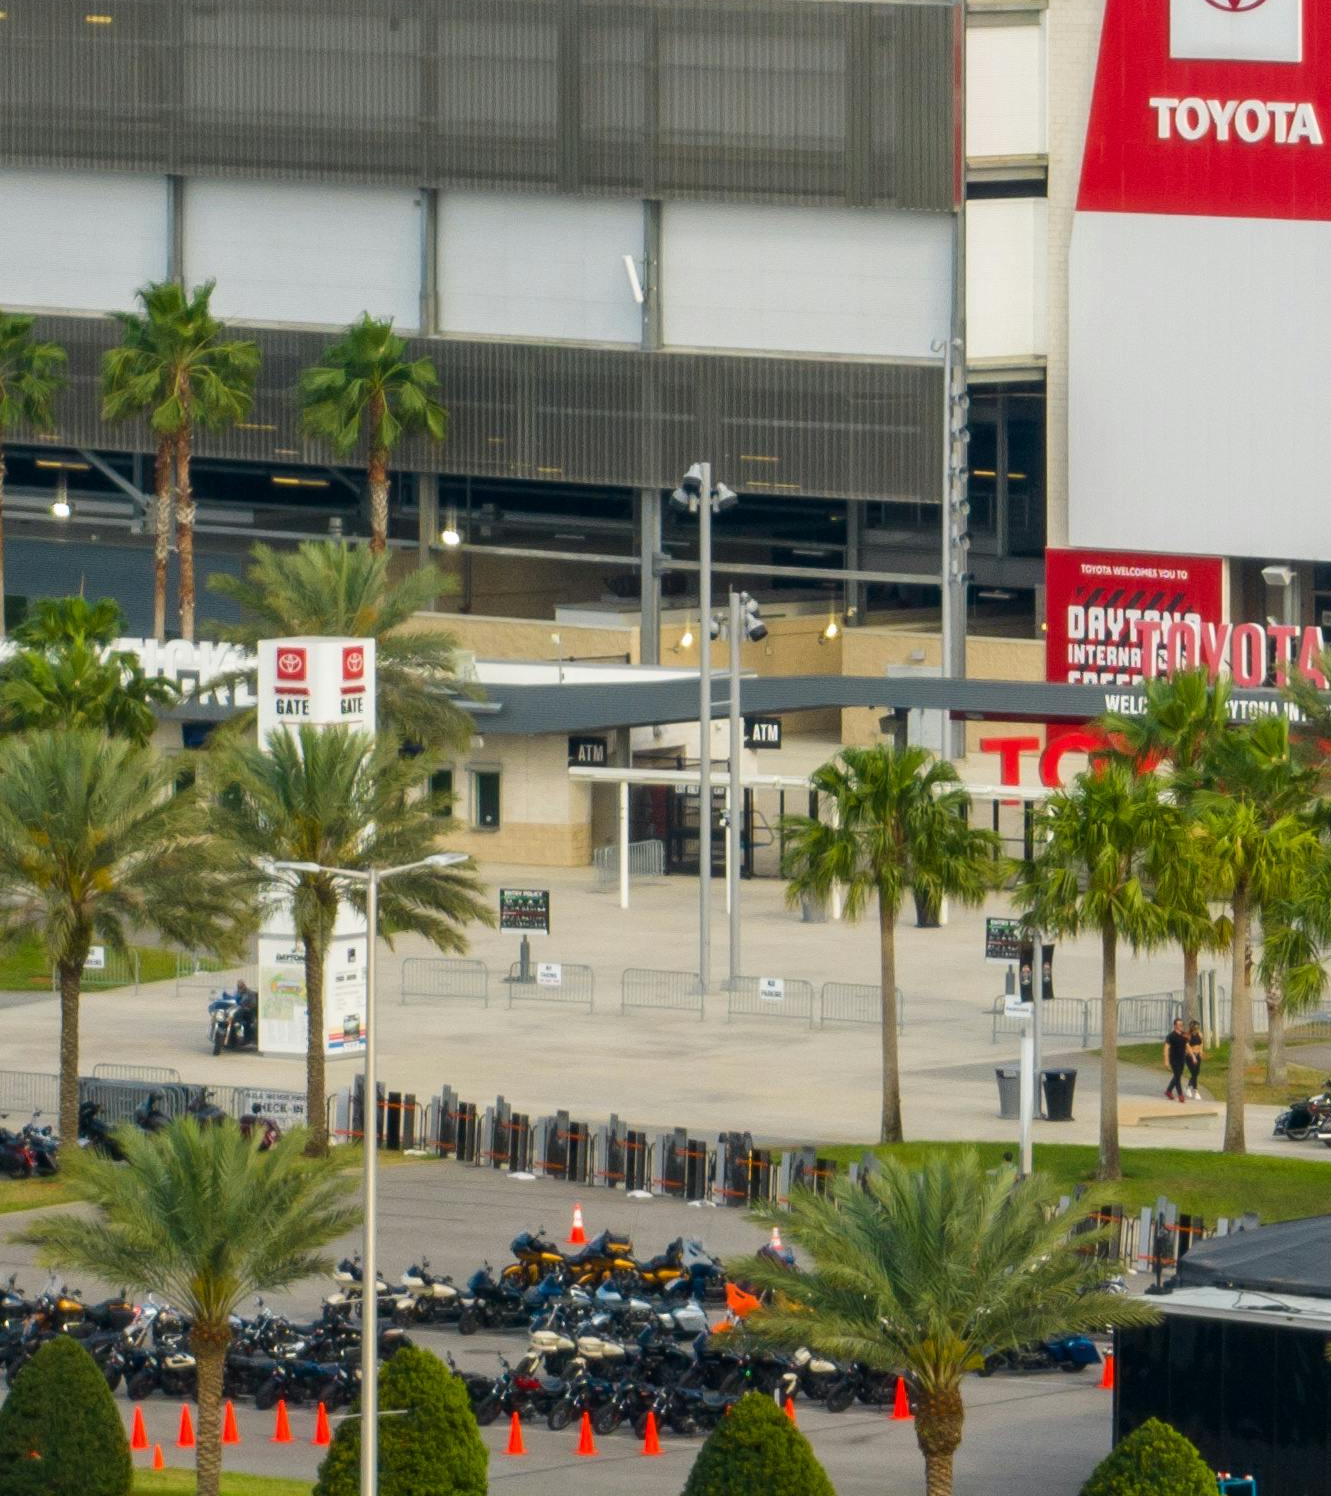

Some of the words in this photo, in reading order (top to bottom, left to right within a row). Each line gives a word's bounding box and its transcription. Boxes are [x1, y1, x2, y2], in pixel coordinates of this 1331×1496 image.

[1149, 96, 1324, 147] TOYOTA
[1081, 564, 1112, 575] TOYOTA
[1112, 566, 1157, 578] WELCOMES
[1159, 568, 1176, 579] YOU
[1177, 570, 1188, 580] TO
[1135, 620, 1330, 691] TOYOTA
[276, 698, 310, 716] GATE
[340, 697, 364, 715] GATE
[1105, 694, 1148, 715] WELC
[753, 723, 779, 741] ATM
[578, 744, 604, 761] ATM
